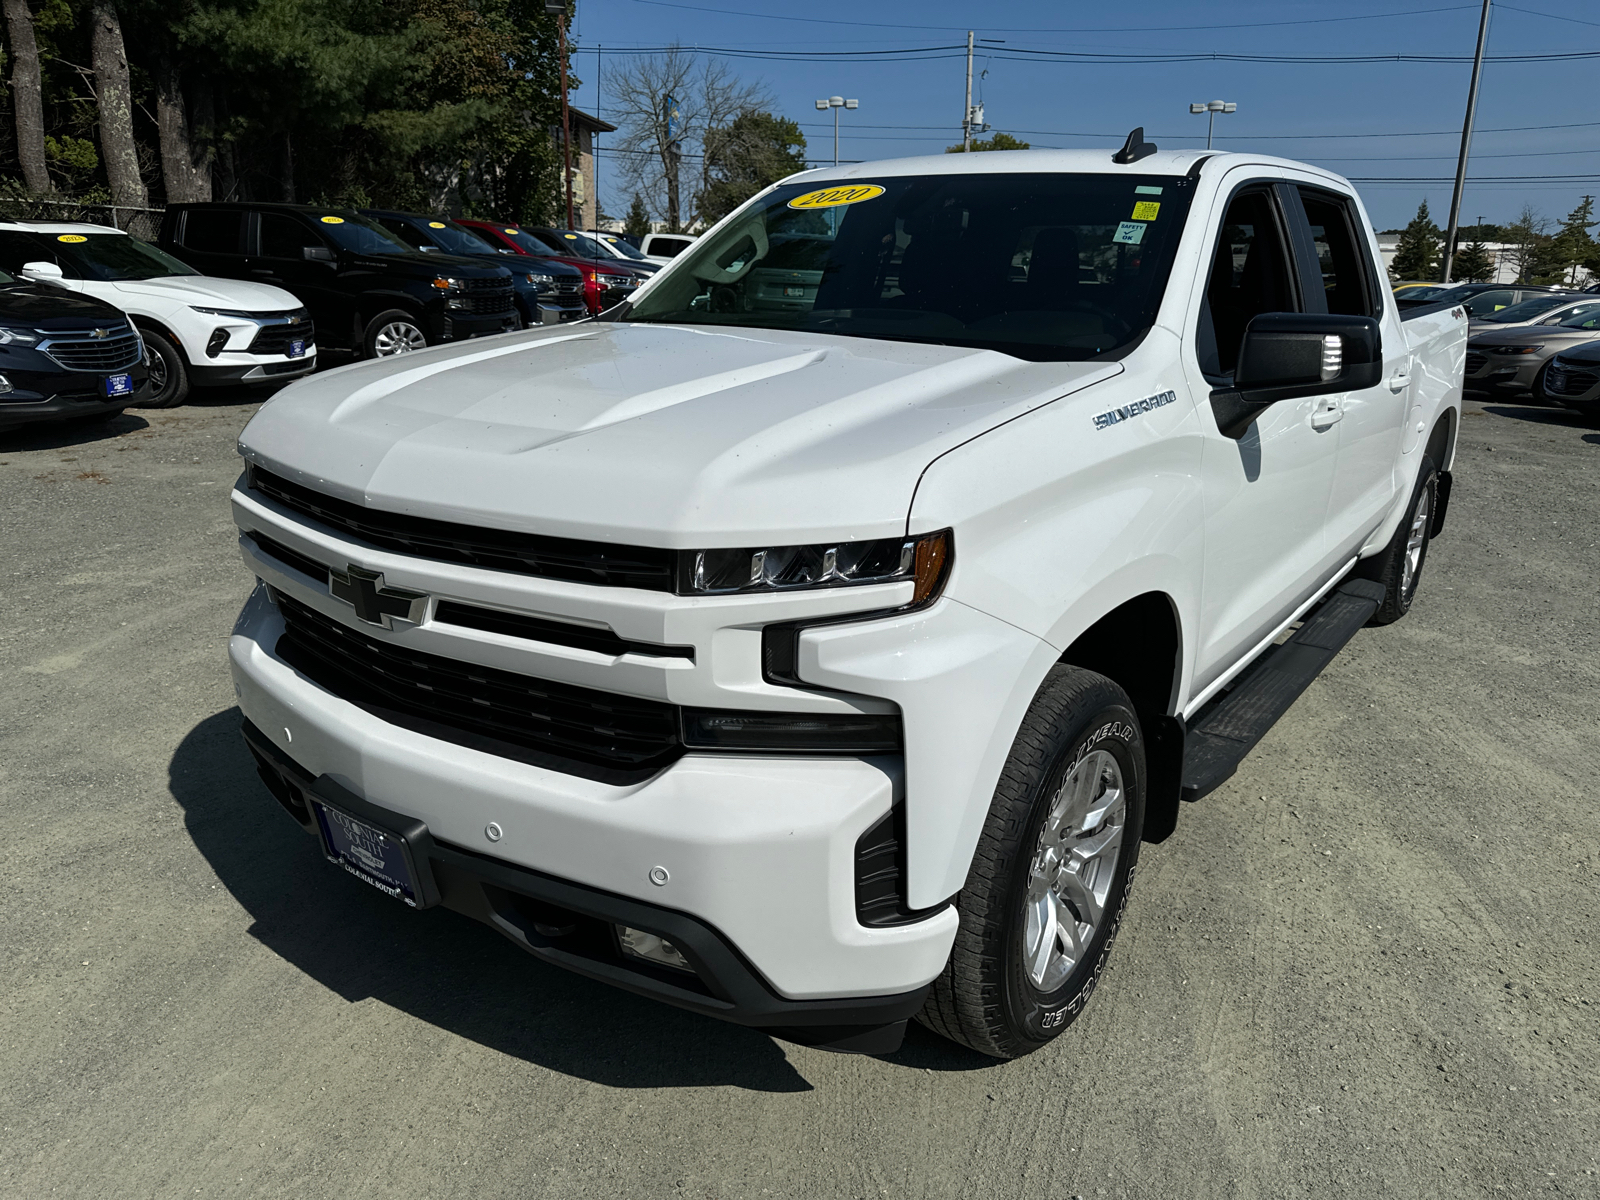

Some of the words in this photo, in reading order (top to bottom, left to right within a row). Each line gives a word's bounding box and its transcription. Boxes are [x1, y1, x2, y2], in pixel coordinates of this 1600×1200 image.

[798, 187, 872, 207] 2020
[1091, 389, 1177, 431] SILVERADO
[332, 811, 390, 850] COLONIAL
[343, 827, 384, 858] SOUTH
[344, 863, 374, 887] COLONIAL
[375, 880, 398, 899] SOUTH
